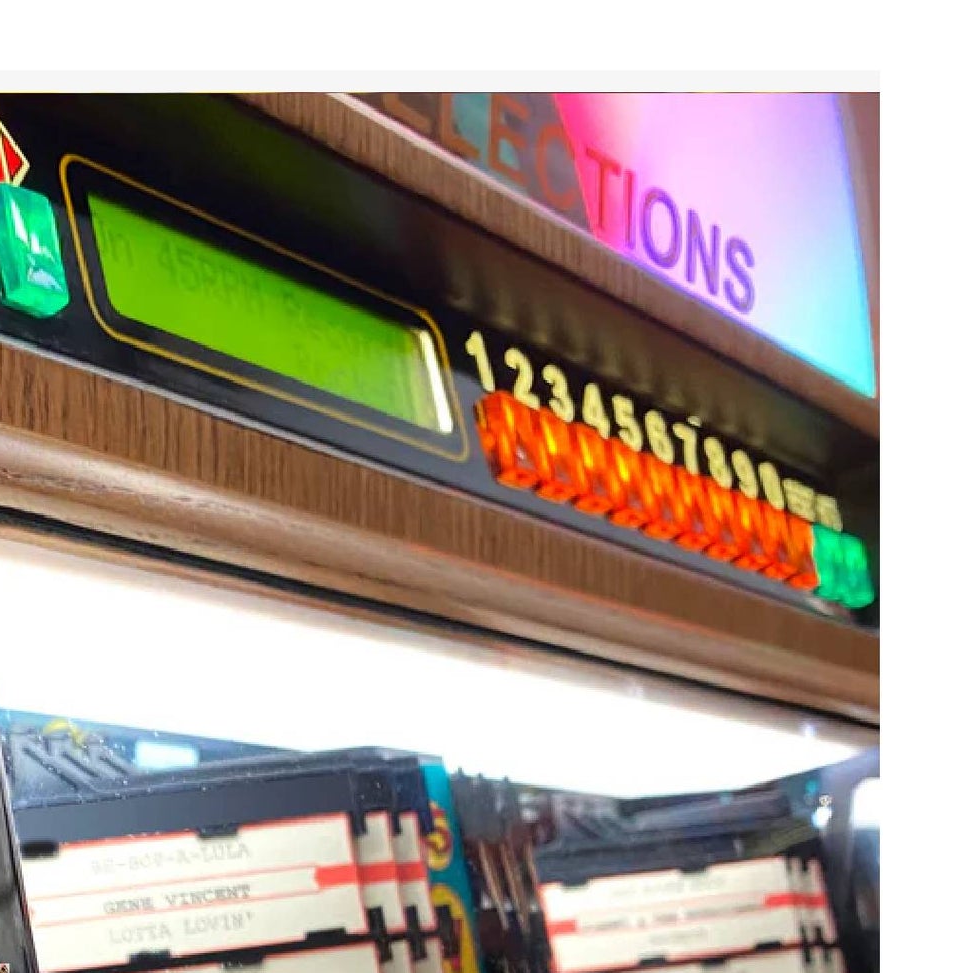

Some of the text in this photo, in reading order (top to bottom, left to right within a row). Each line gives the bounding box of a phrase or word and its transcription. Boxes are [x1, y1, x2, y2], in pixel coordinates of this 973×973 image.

[103, 884, 251, 915] GENE VINCENT
[110, 911, 253, 945] LOTTA LOVIN'
